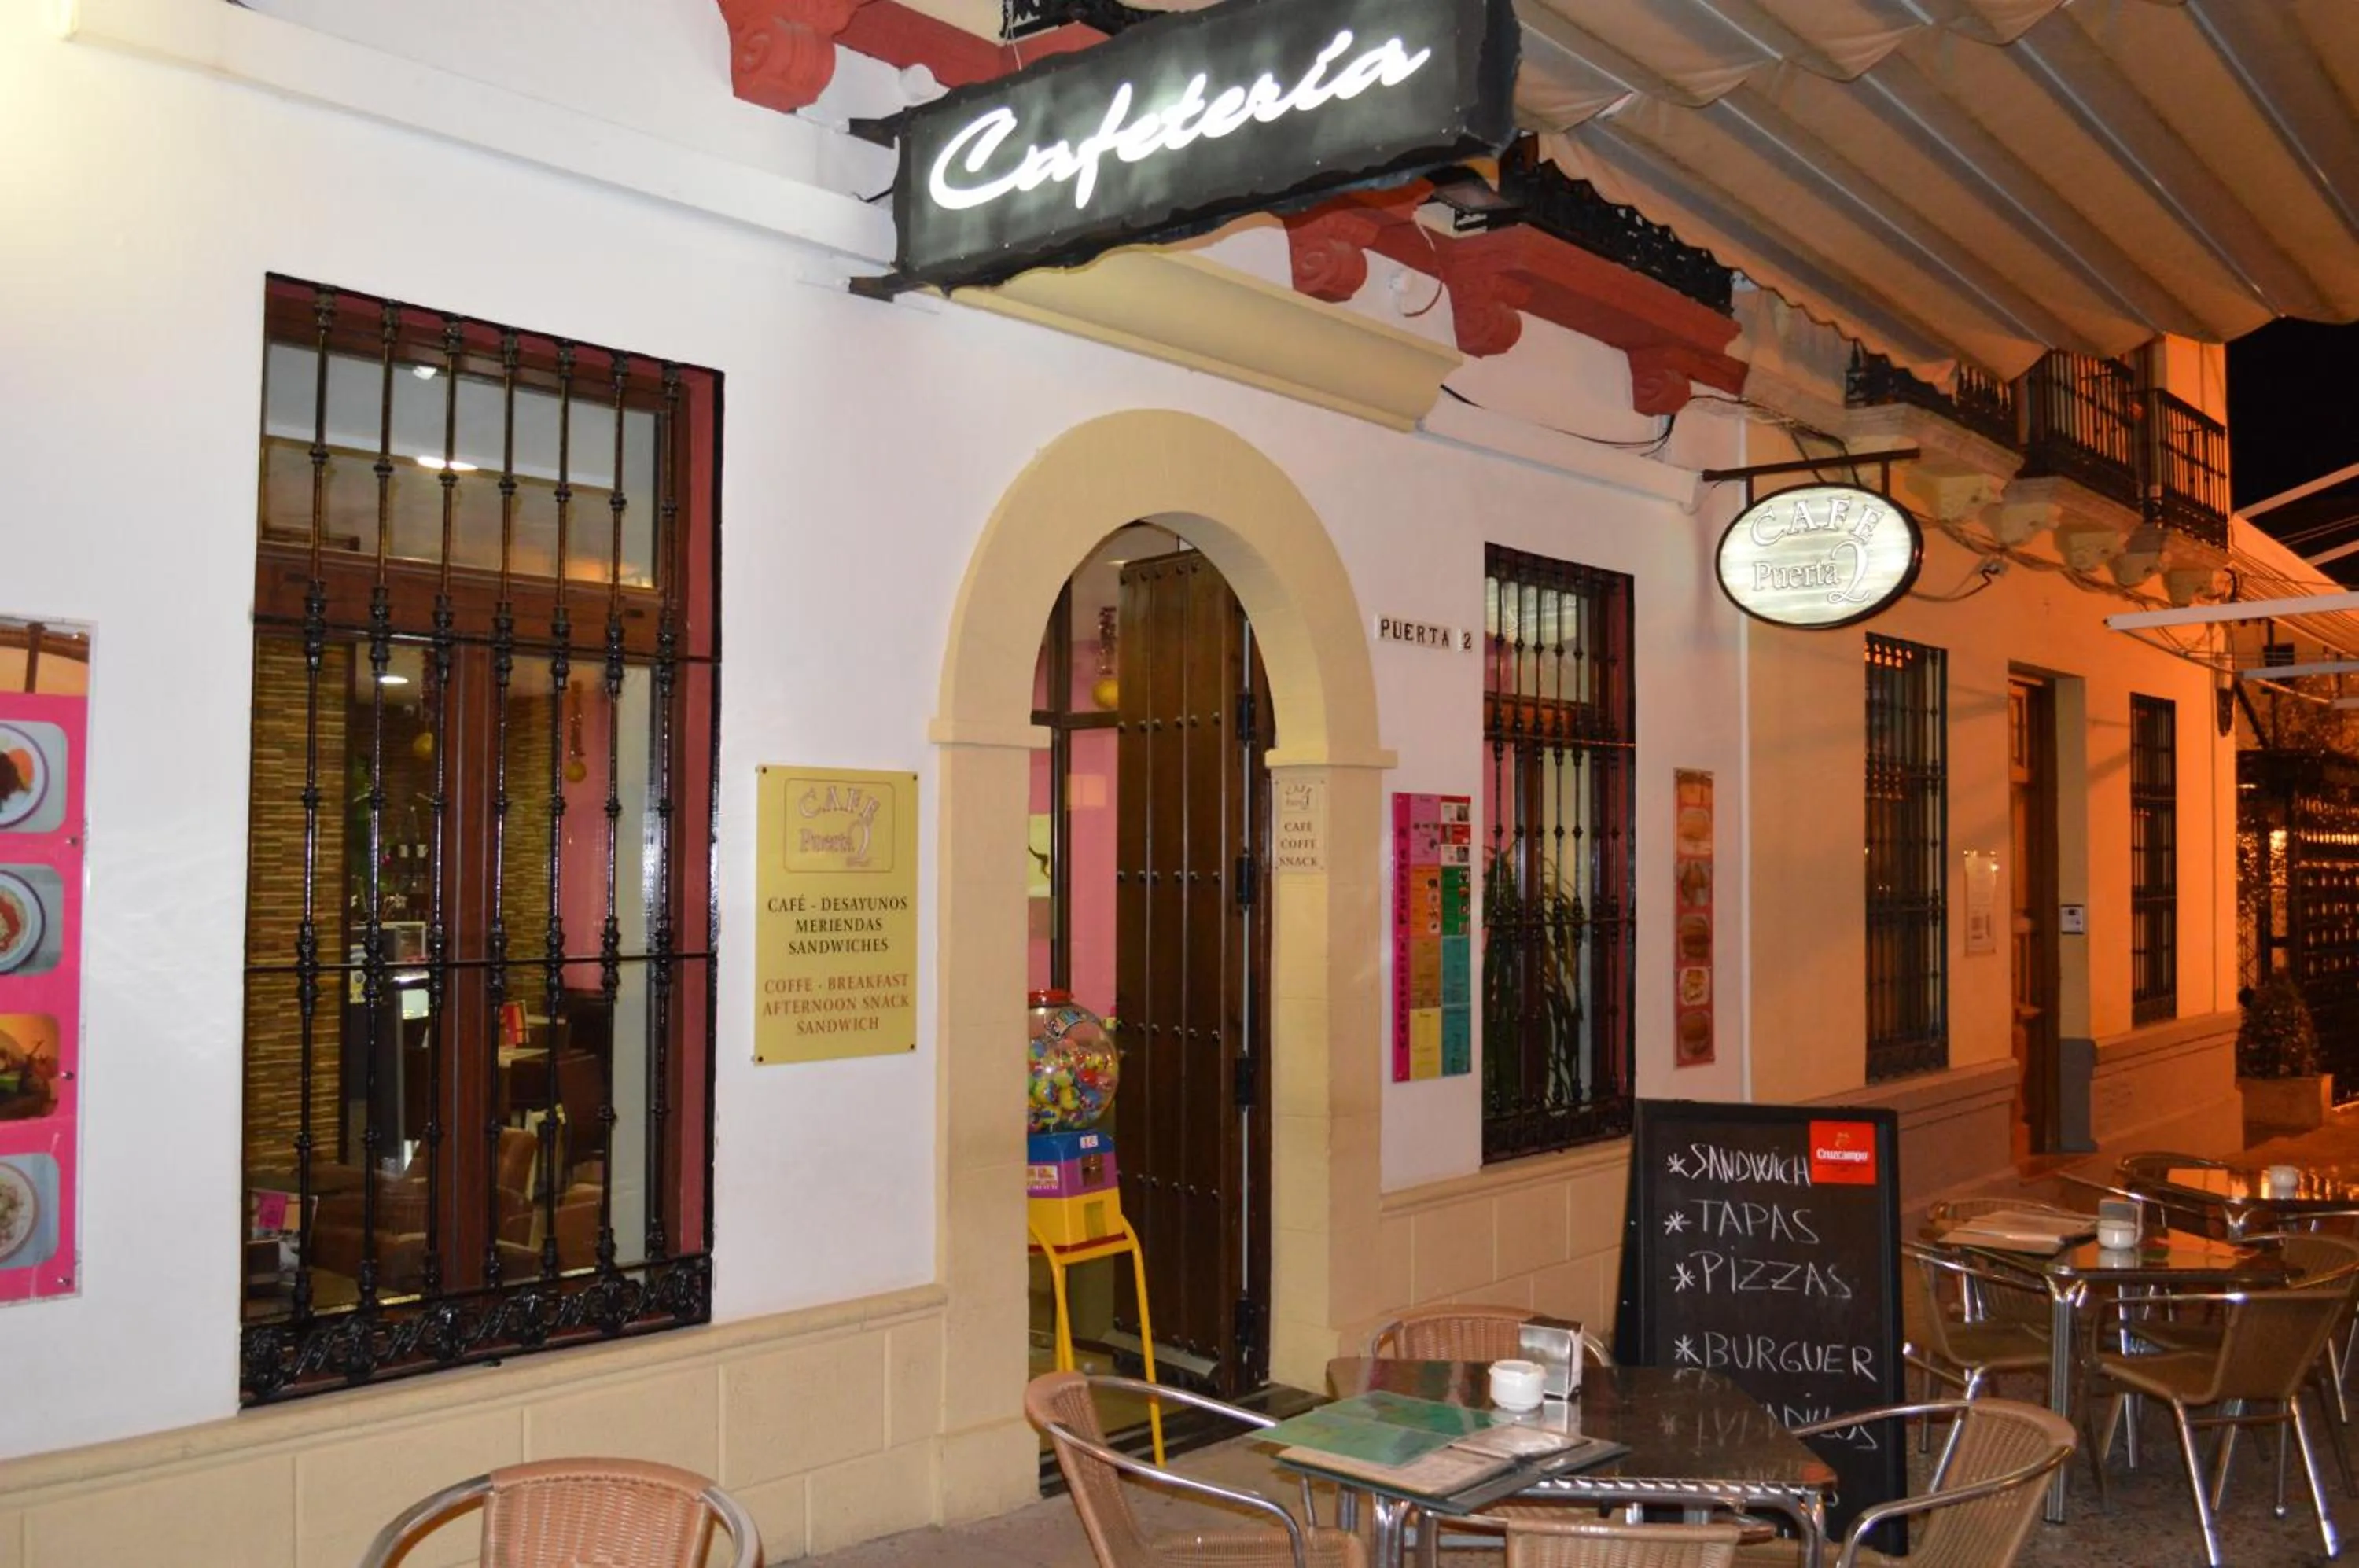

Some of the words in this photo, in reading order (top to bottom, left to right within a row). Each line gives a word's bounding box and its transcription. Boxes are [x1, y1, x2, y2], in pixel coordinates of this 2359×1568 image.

[1750, 496, 1885, 546] CAFE
[1753, 560, 1841, 591] Puerta
[1827, 539, 1872, 604] 2
[1380, 618, 1450, 648] PUERTA
[1463, 632, 1472, 650] 2
[767, 895, 806, 913] CAFÉ
[820, 896, 907, 911] DESAYUNOS
[794, 918, 883, 934] MERIENDAS
[789, 937, 889, 955] SANDWICHES
[764, 977, 812, 994] COFFE
[828, 974, 908, 991] BREAKFAST
[762, 998, 856, 1016] AFTERNOON
[862, 994, 909, 1008] SNACK
[796, 1016, 879, 1036] SANDWICH
[1690, 1199, 1820, 1244] TAPAS
[1703, 1331, 1877, 1382] BURGUER
